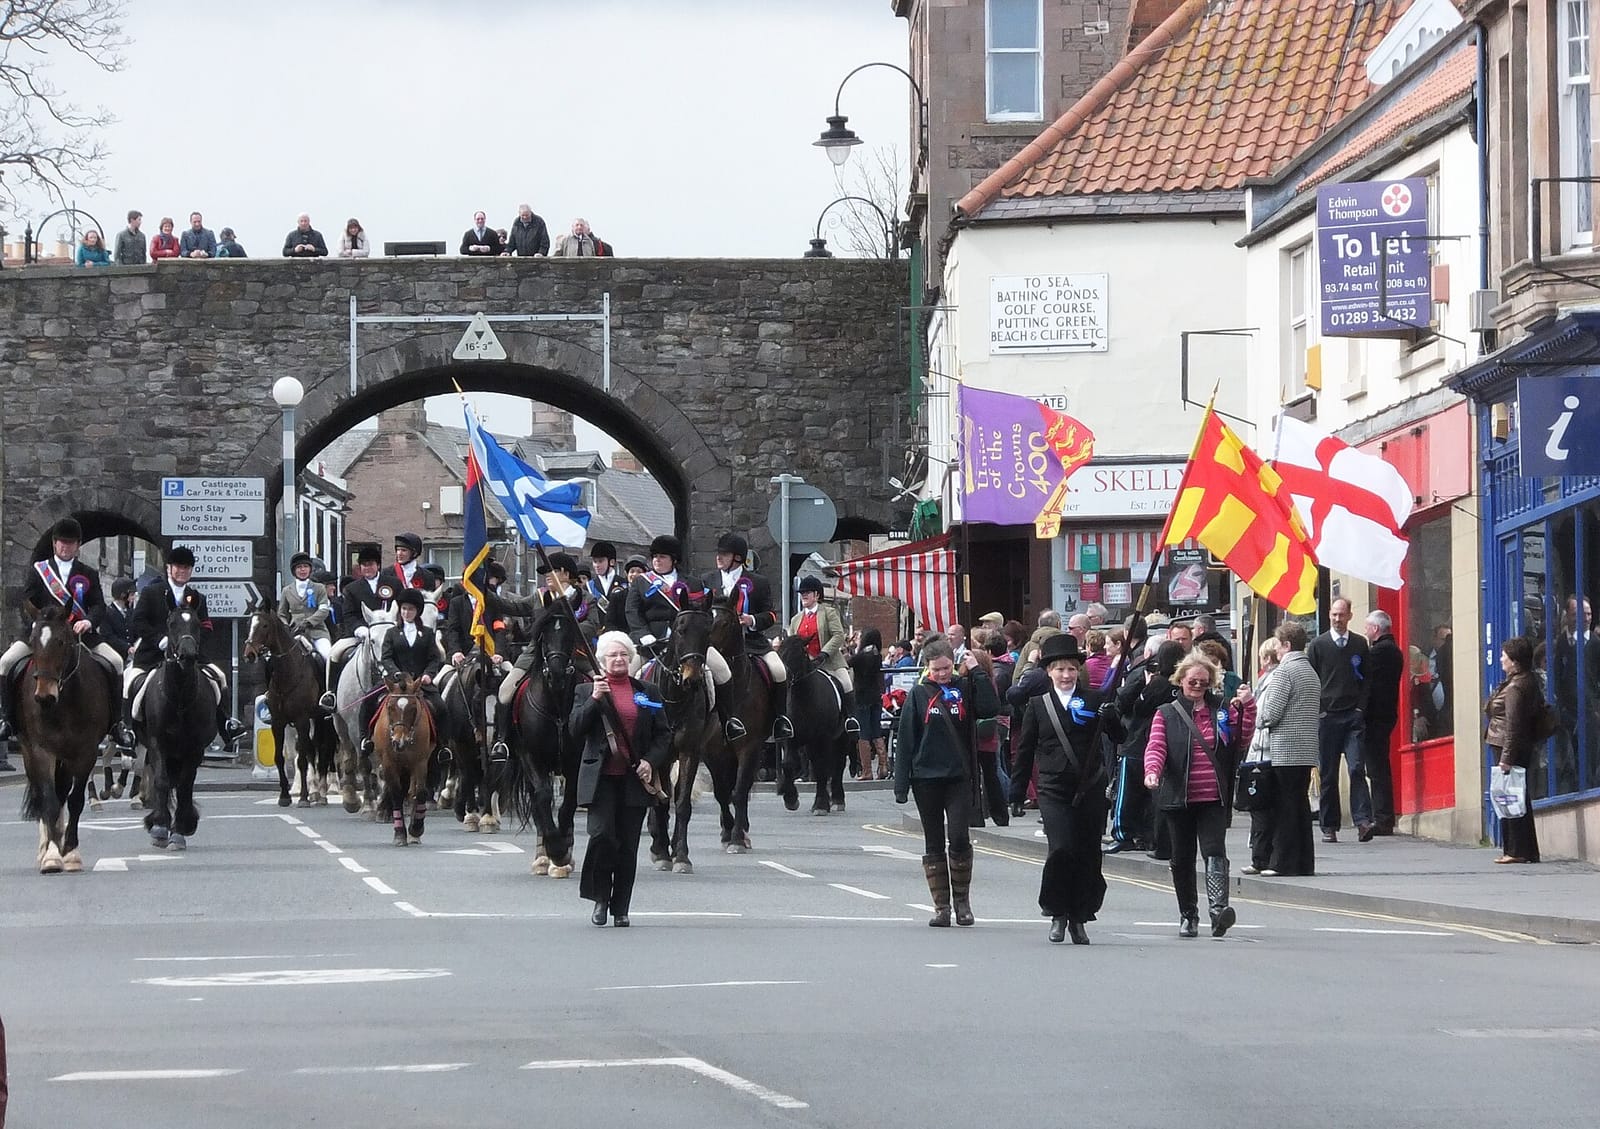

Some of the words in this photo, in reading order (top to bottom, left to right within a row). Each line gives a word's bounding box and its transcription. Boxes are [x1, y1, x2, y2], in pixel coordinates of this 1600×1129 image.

[1328, 197, 1358, 208] Edwin
[1328, 208, 1378, 221] Thompson
[1332, 233, 1363, 259] To
[1371, 230, 1411, 257] Let
[1343, 262, 1376, 277] Retail
[1387, 260, 1405, 274] nit
[1024, 277, 1041, 288] TO
[1325, 282, 1349, 293] 93.74
[1351, 283, 1362, 292] sq
[1404, 279, 1416, 289] sq
[997, 290, 1048, 303] BATHING
[1004, 304, 1036, 316] GOLF
[1331, 299, 1416, 311] www.edwin-thoson.co.uk
[998, 317, 1049, 329] PUTTING
[1331, 311, 1368, 325] 01289
[991, 331, 1027, 342] BEACH
[1030, 331, 1037, 341] &
[1082, 328, 1107, 340] ETC.
[986, 430, 1003, 461] the
[1008, 423, 1026, 499] Crowns
[201, 480, 247, 488] Castlegate
[989, 468, 1002, 489] of
[180, 504, 203, 512] Short
[206, 504, 225, 512] Stay
[1153, 499, 1173, 509] 176
[203, 514, 223, 522] Stay
[204, 542, 246, 553] vehicles
[203, 554, 213, 563] to
[216, 555, 249, 563] centre
[194, 564, 205, 573] of
[207, 564, 230, 573] arch
